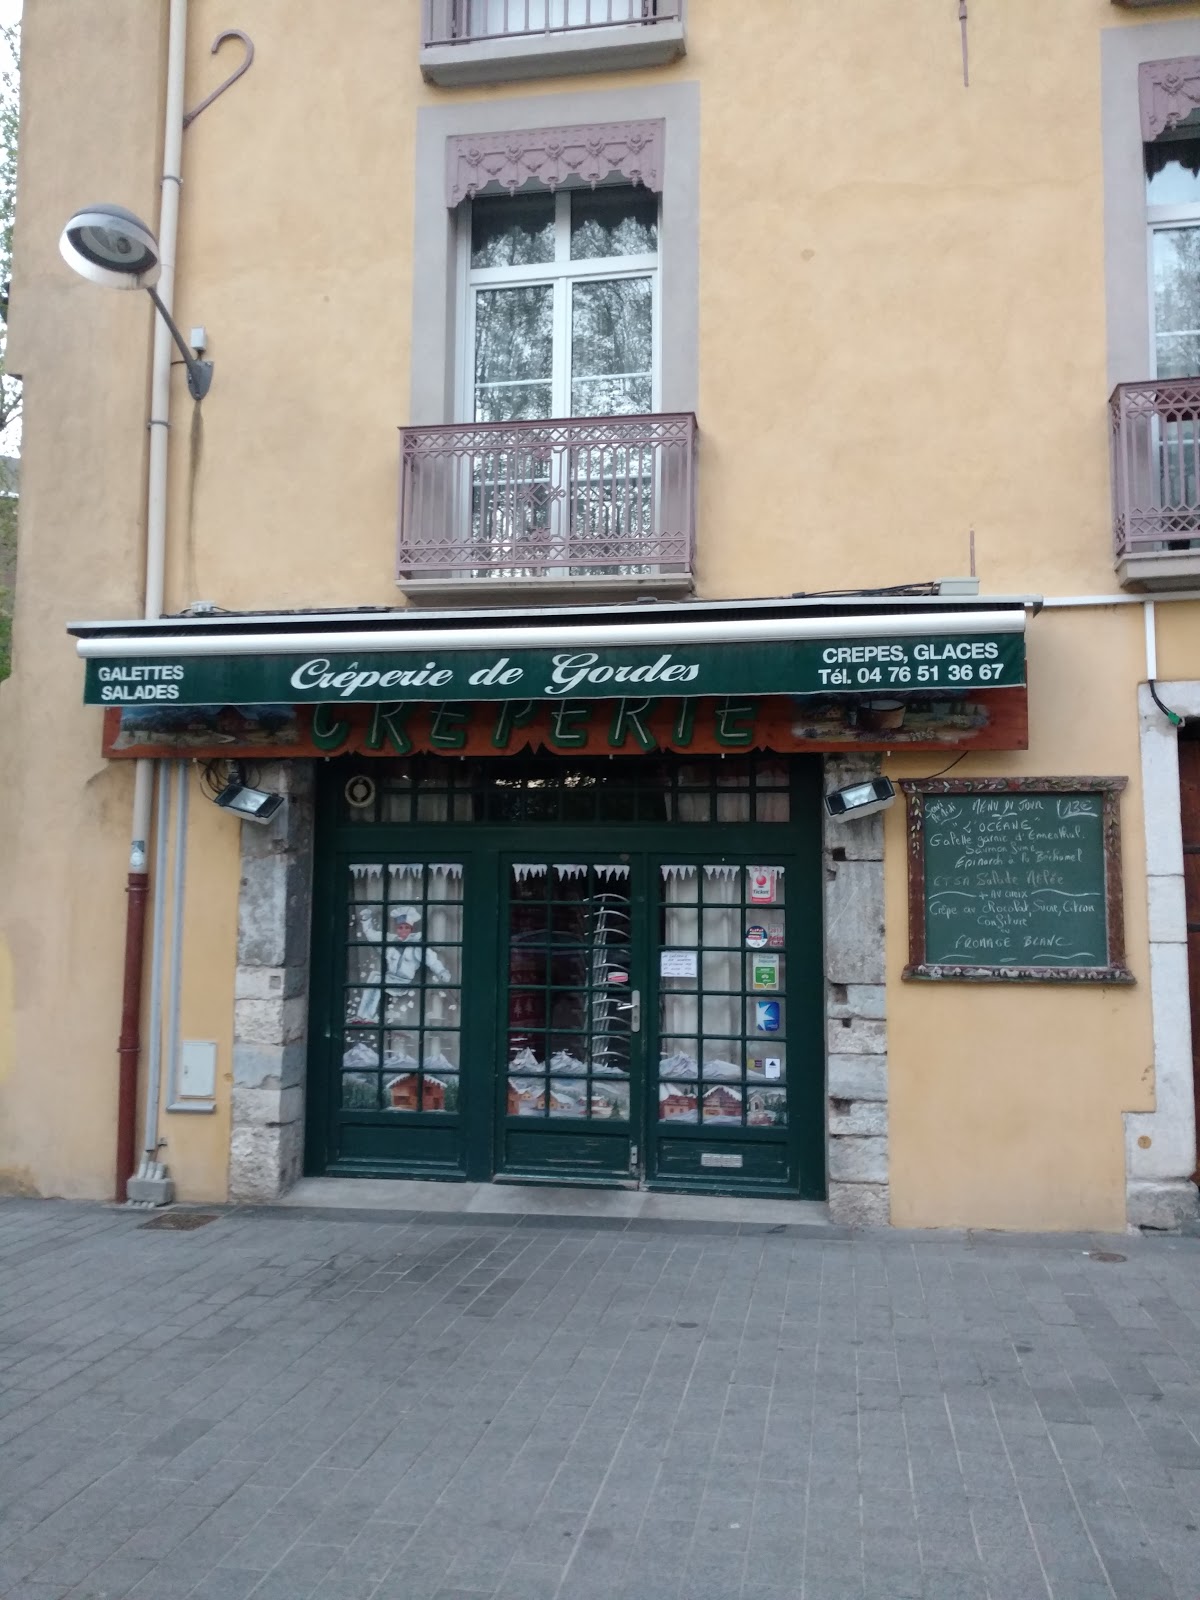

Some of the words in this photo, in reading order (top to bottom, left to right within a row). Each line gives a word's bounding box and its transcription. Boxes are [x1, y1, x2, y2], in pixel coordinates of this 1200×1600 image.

[822, 645, 909, 665] CREPES,
[913, 642, 999, 661] GLACES
[98, 665, 184, 683] GALETTES
[290, 658, 454, 697] Crêperie
[469, 658, 524, 687] de
[545, 653, 700, 695] Gordes
[818, 667, 852, 686] Tél.
[857, 667, 882, 684] 04
[887, 666, 912, 683] 76
[916, 665, 940, 682] 51
[947, 664, 974, 681] 36
[978, 663, 1005, 680] 67
[101, 684, 180, 700] SALADES
[972, 799, 999, 814] MENU
[1018, 799, 1044, 811] JOUR
[930, 833, 972, 847] Galette
[977, 835, 1008, 848] garnie
[965, 845, 1008, 855] Saumon
[929, 901, 957, 918] Crêpe
[963, 905, 976, 914] au
[1062, 900, 1096, 914] Citron
[955, 935, 1011, 949] FROMAGE
[1024, 935, 1072, 947] BLANC
